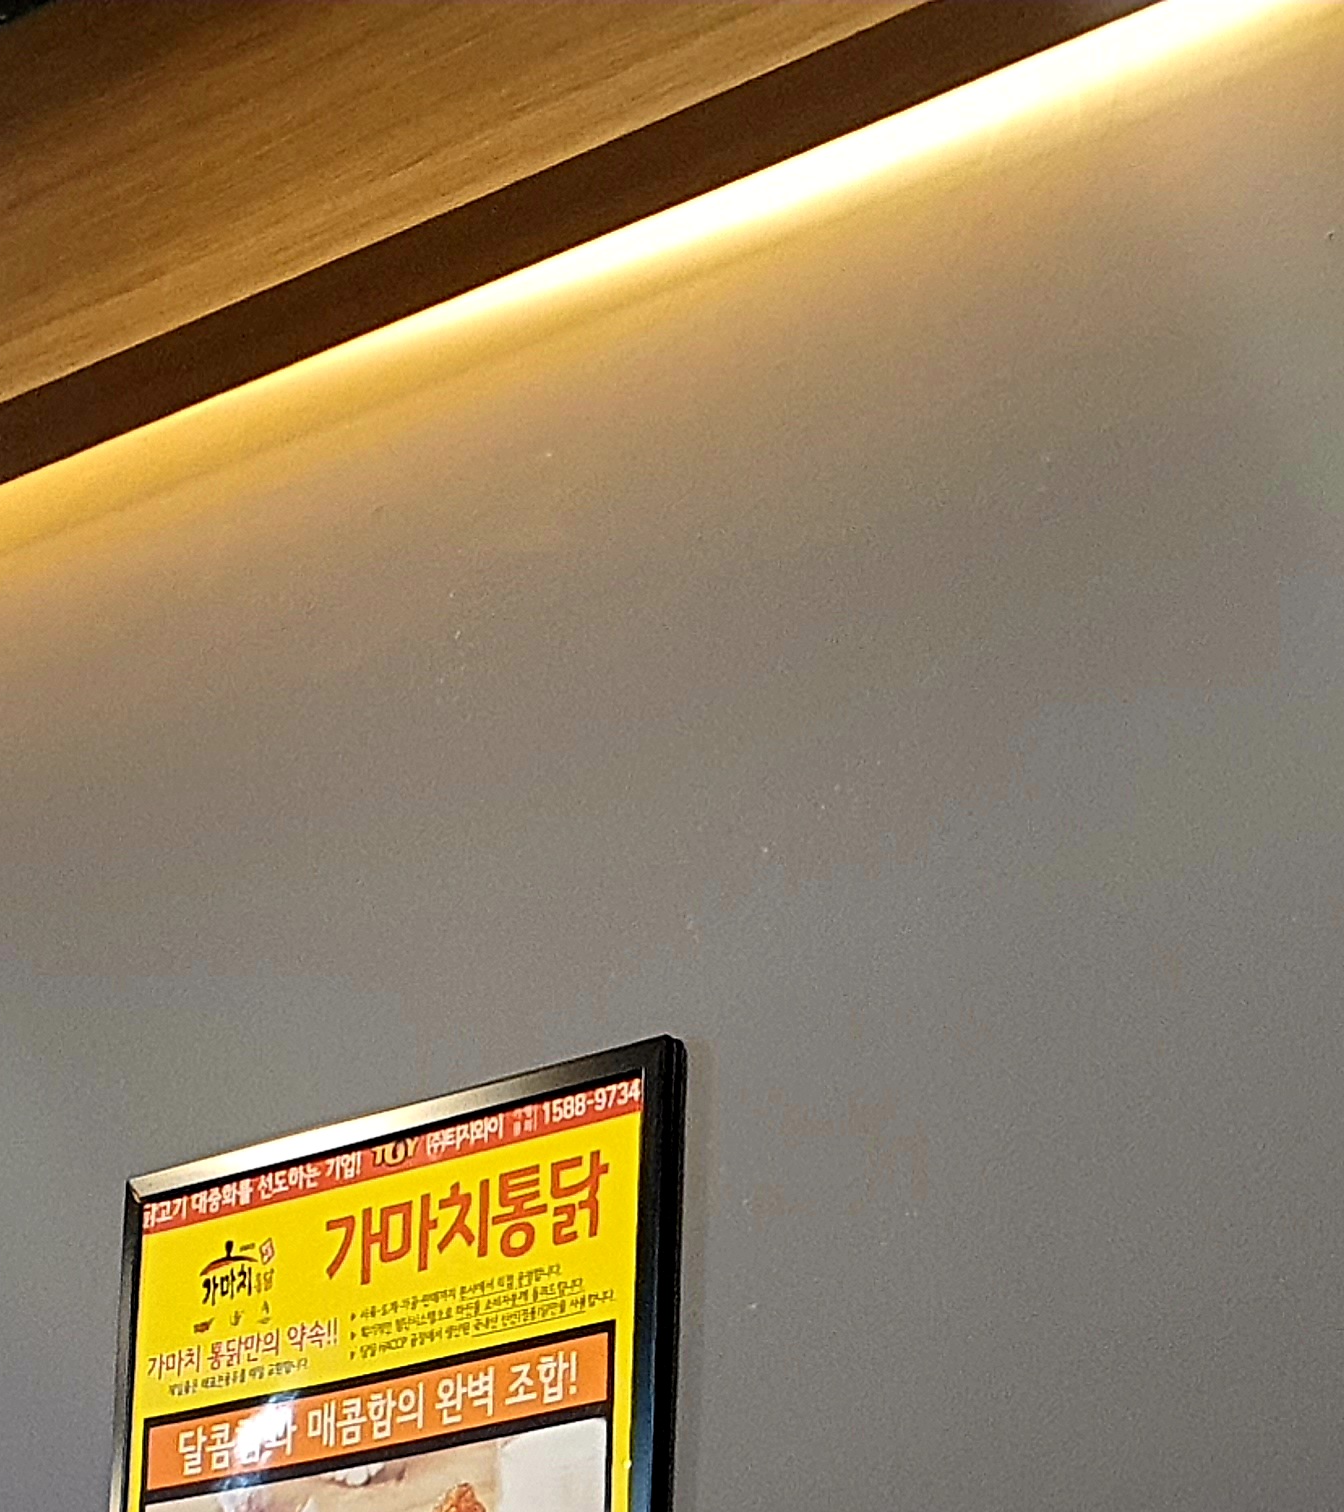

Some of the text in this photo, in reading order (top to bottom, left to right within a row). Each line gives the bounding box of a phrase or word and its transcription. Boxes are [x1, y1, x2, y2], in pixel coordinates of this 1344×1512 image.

[257, 1162, 322, 1199] 선도하는
[325, 1150, 362, 1181] 기업!
[542, 1078, 642, 1124] 1588-9734
[325, 1149, 610, 1286] 가마치통닭
[202, 1263, 252, 1306] 가마치
[147, 1345, 201, 1380] 가마치
[207, 1328, 280, 1370] 통닭만의
[287, 1317, 338, 1352] 약속!!
[178, 1408, 299, 1476] 달콤과
[307, 1381, 424, 1448] 매콤함의
[435, 1366, 495, 1426] 완벽
[505, 1350, 578, 1407] 조합!
